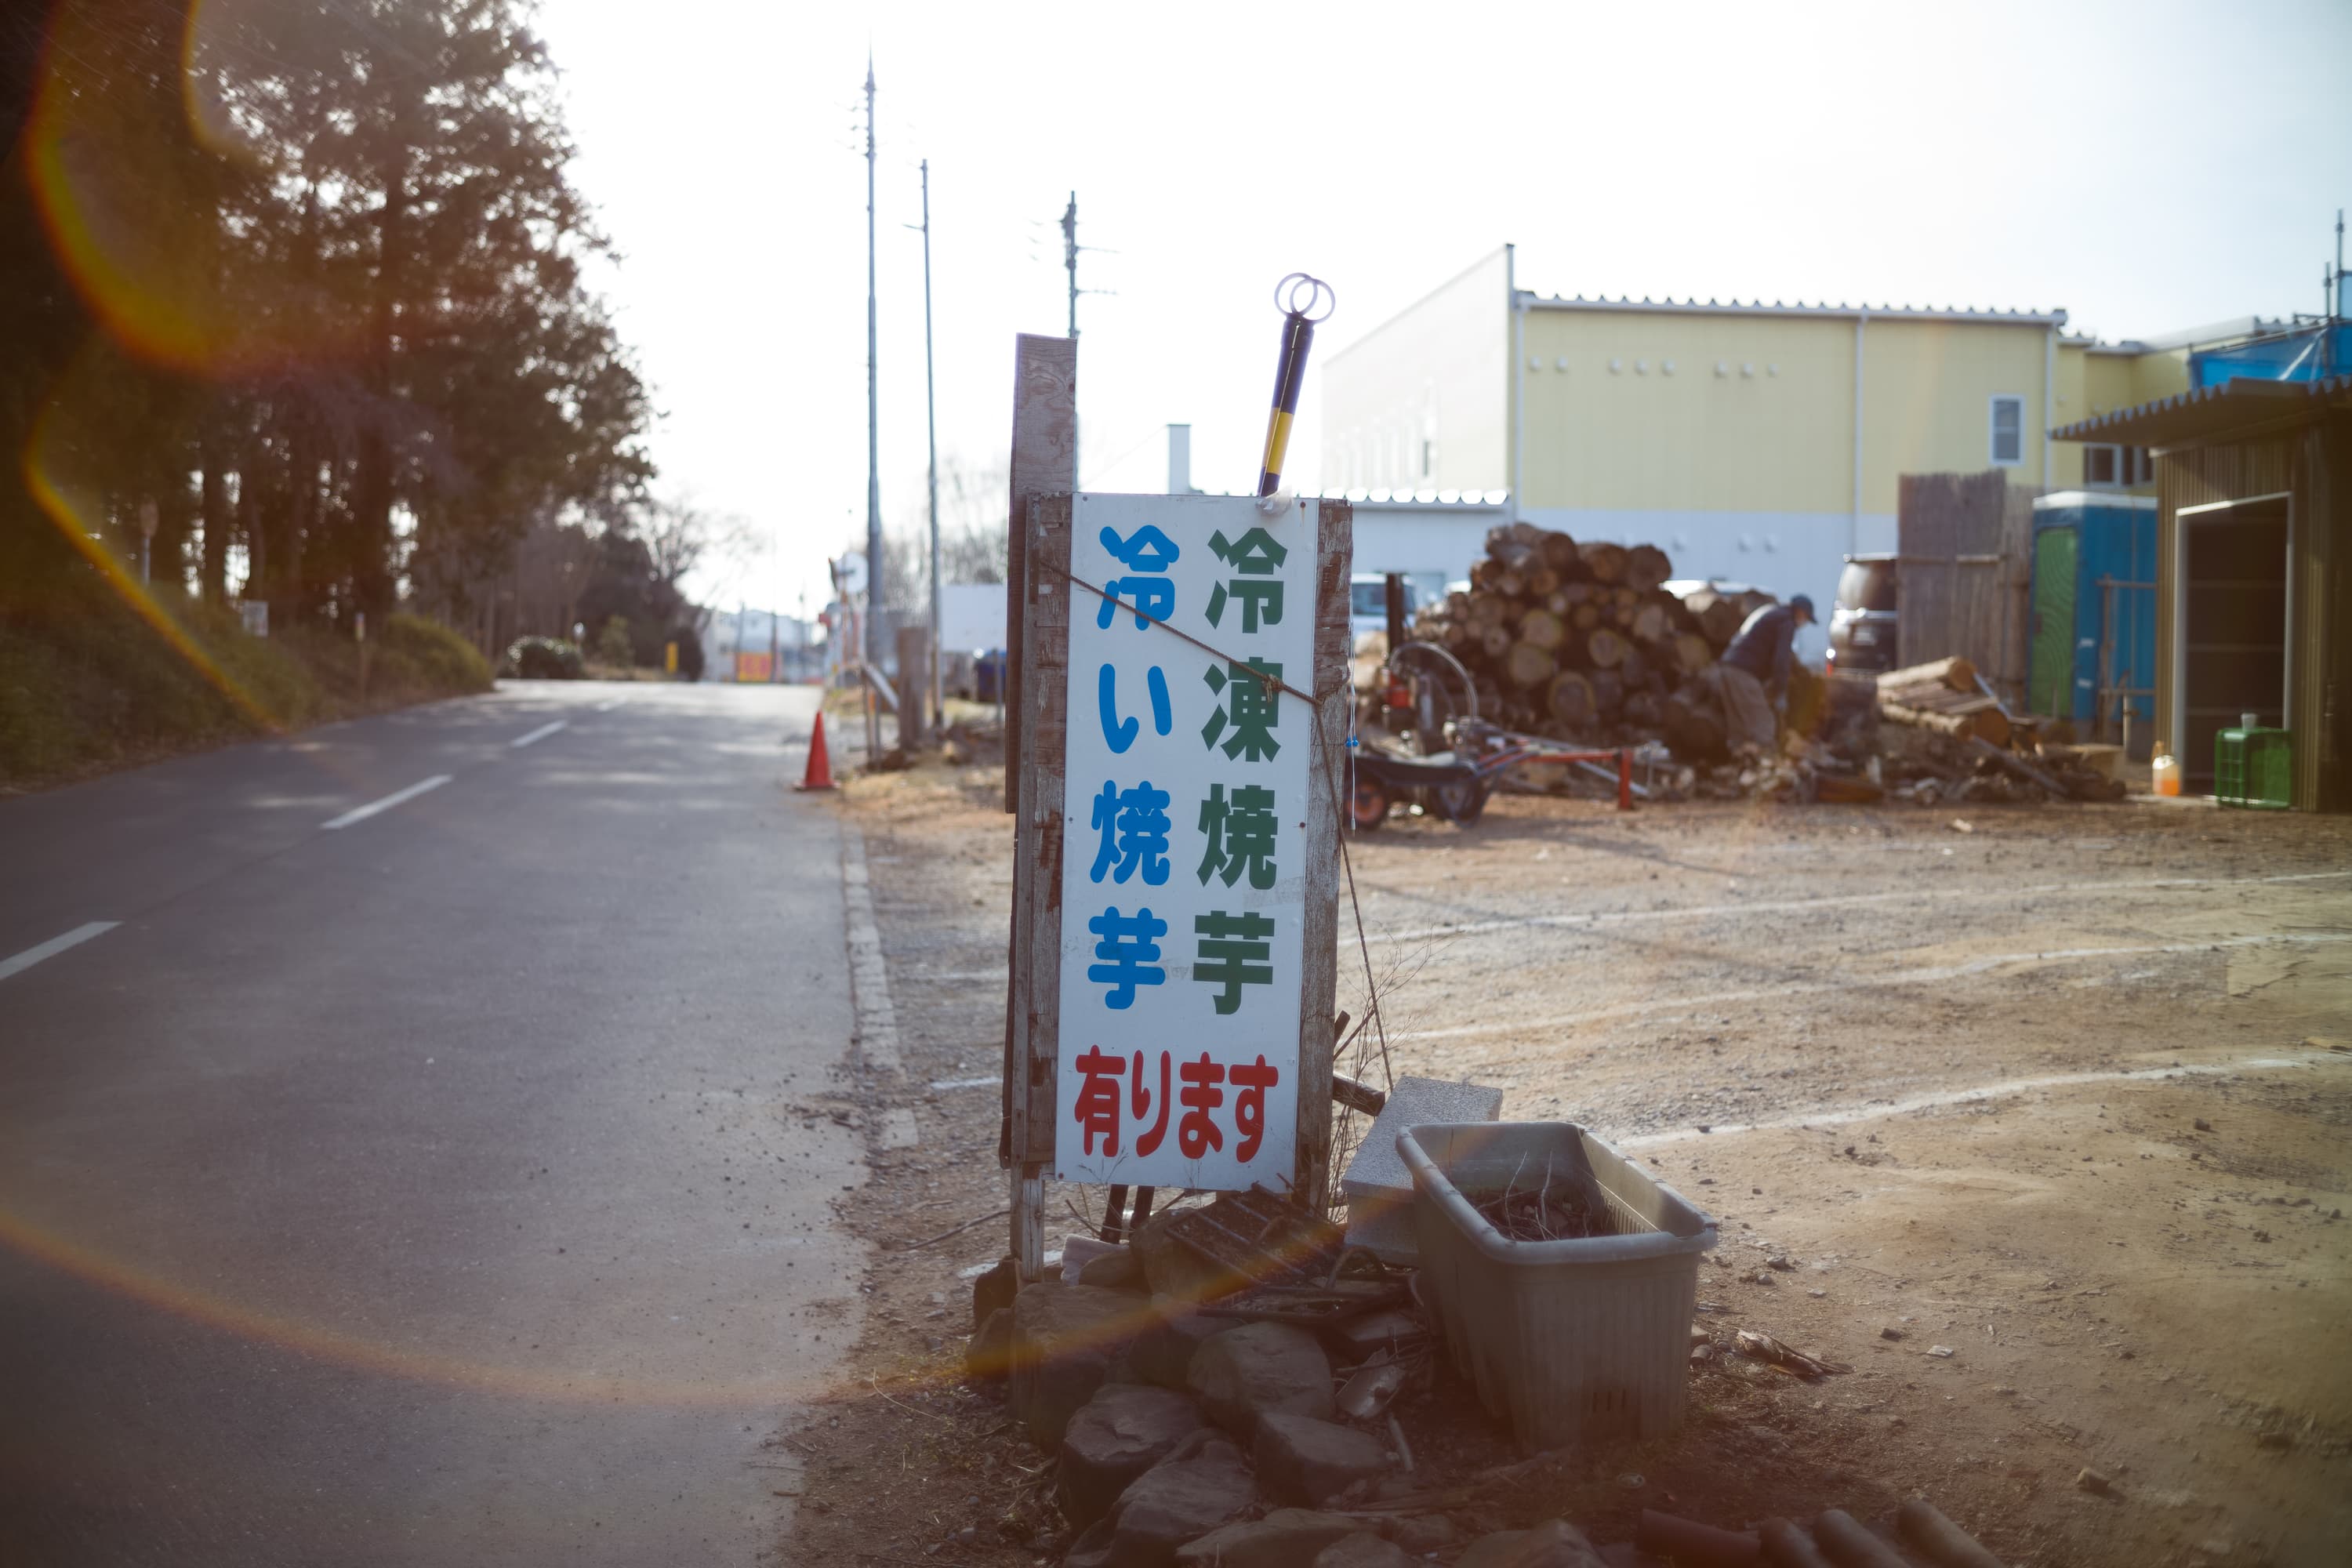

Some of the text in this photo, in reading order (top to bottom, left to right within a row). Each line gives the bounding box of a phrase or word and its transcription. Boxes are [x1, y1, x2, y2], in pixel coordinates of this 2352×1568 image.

[1087, 524, 1180, 1011] 冷い焼芋
[1192, 527, 1288, 1015] 冷凍焼芋
[1074, 1044, 1279, 1163] 有ります
